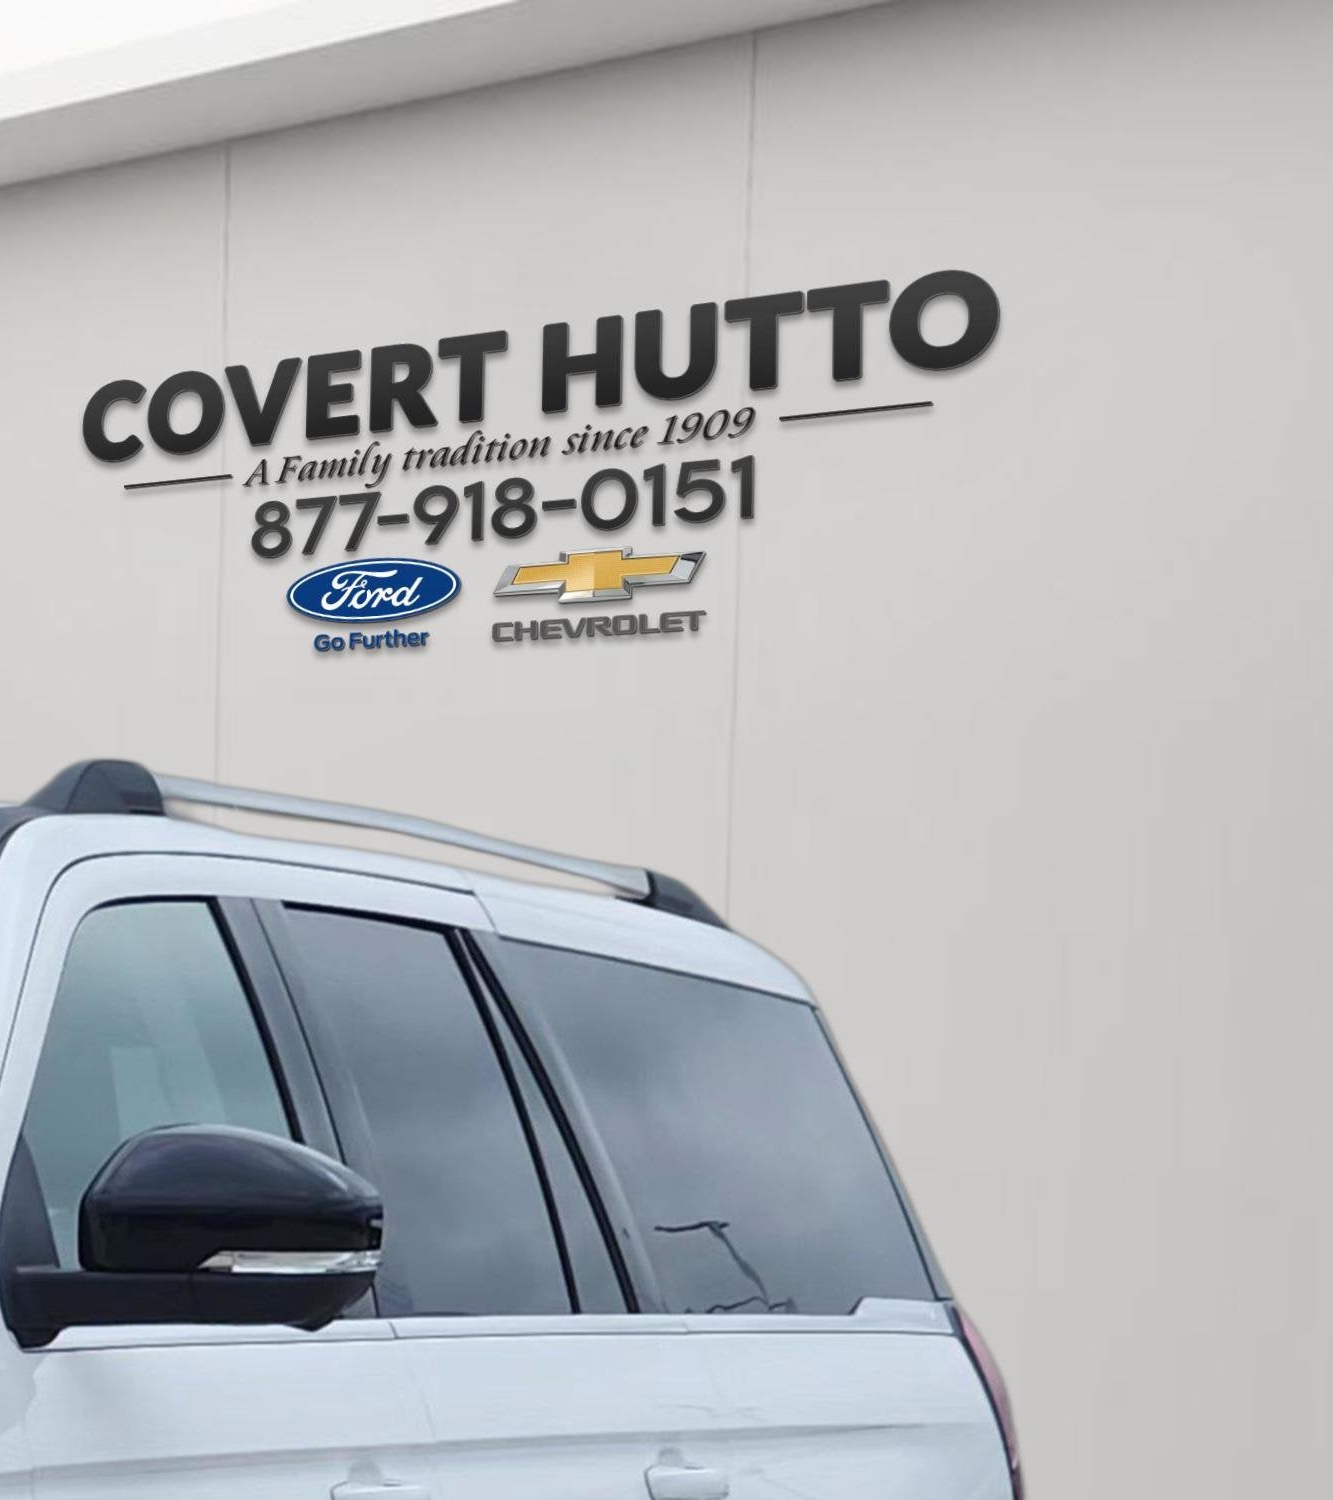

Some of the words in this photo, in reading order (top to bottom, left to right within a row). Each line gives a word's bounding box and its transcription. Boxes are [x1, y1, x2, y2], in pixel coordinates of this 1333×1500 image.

[82, 330, 509, 463] COVERT
[541, 269, 1001, 414] HUTTO
[243, 458, 271, 488] A
[275, 441, 393, 489] Family
[402, 430, 552, 471] tradition
[561, 424, 650, 456] since
[656, 406, 757, 446] 1909
[251, 454, 756, 559] 877-918-0151
[320, 569, 424, 611] Ford
[314, 634, 346, 653] Go
[348, 628, 430, 651] Further
[492, 610, 707, 643] CHEVROLET
